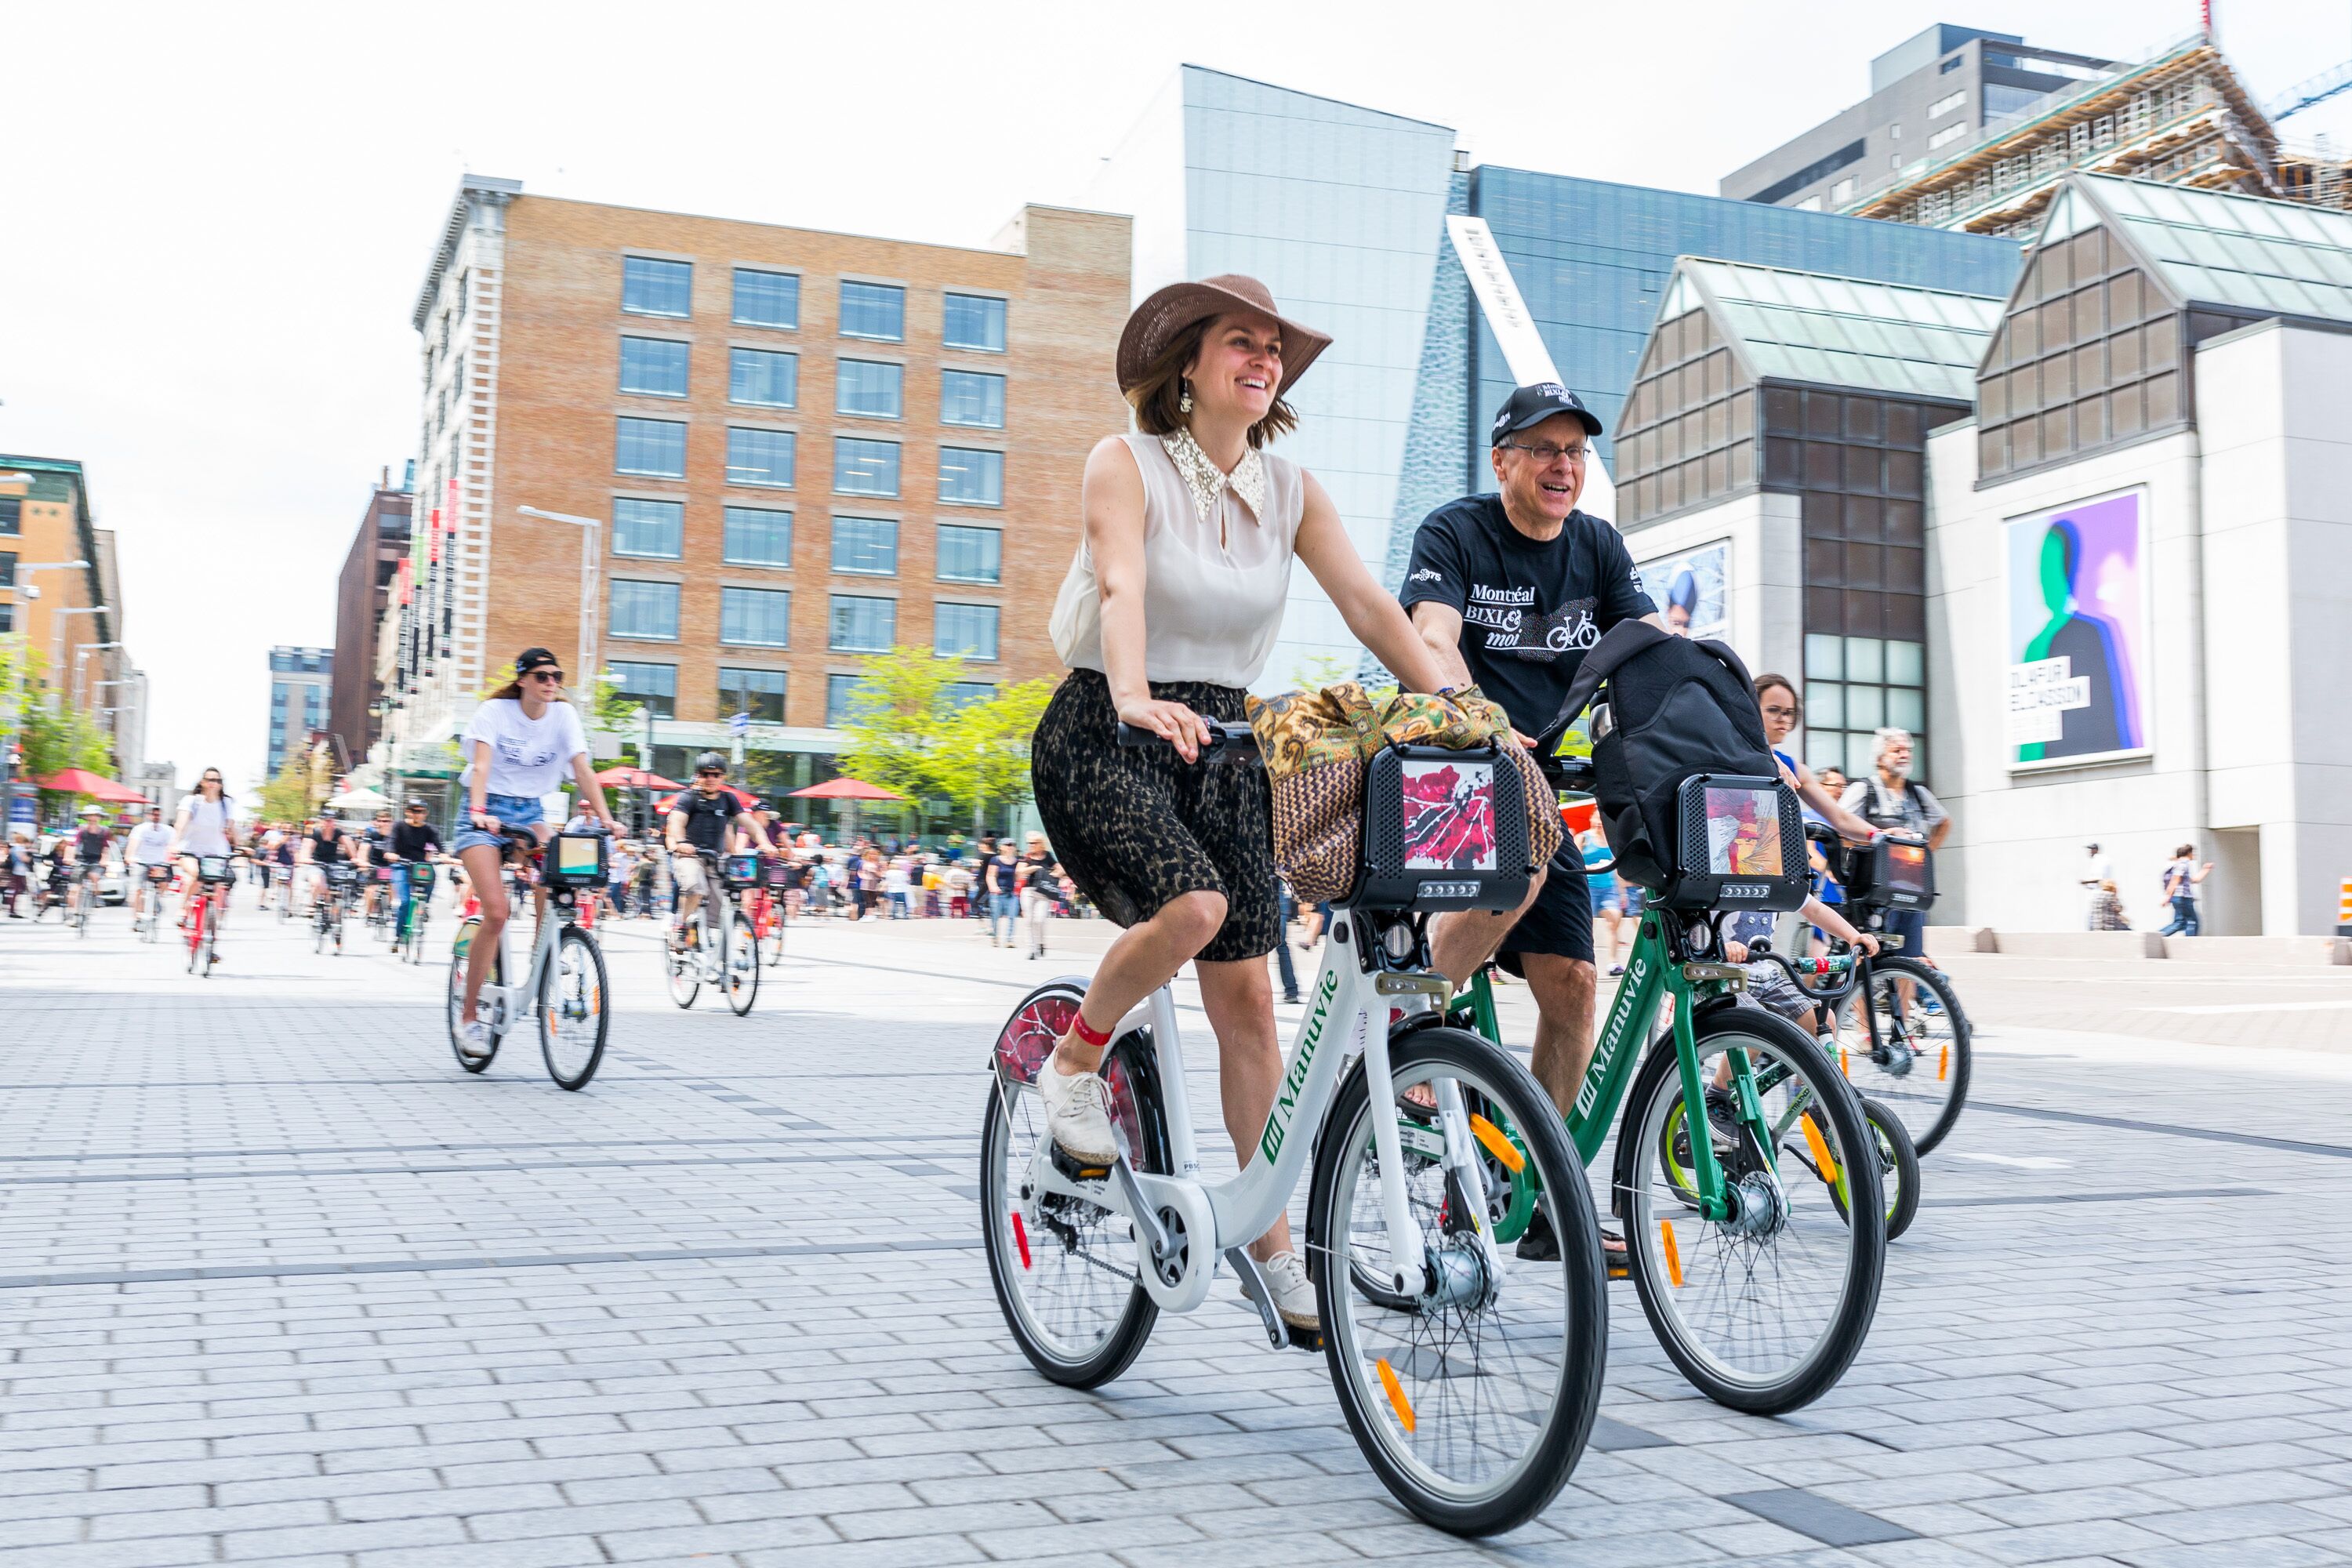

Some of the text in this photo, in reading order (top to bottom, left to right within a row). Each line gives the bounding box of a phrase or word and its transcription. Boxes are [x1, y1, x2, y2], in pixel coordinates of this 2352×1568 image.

[1472, 584, 1534, 602] Montréal
[1465, 604, 1522, 632] BIXI &
[1486, 628, 1521, 647] moi
[1591, 958, 1646, 1085] Manuvie
[1279, 969, 1338, 1123] Manuvie
